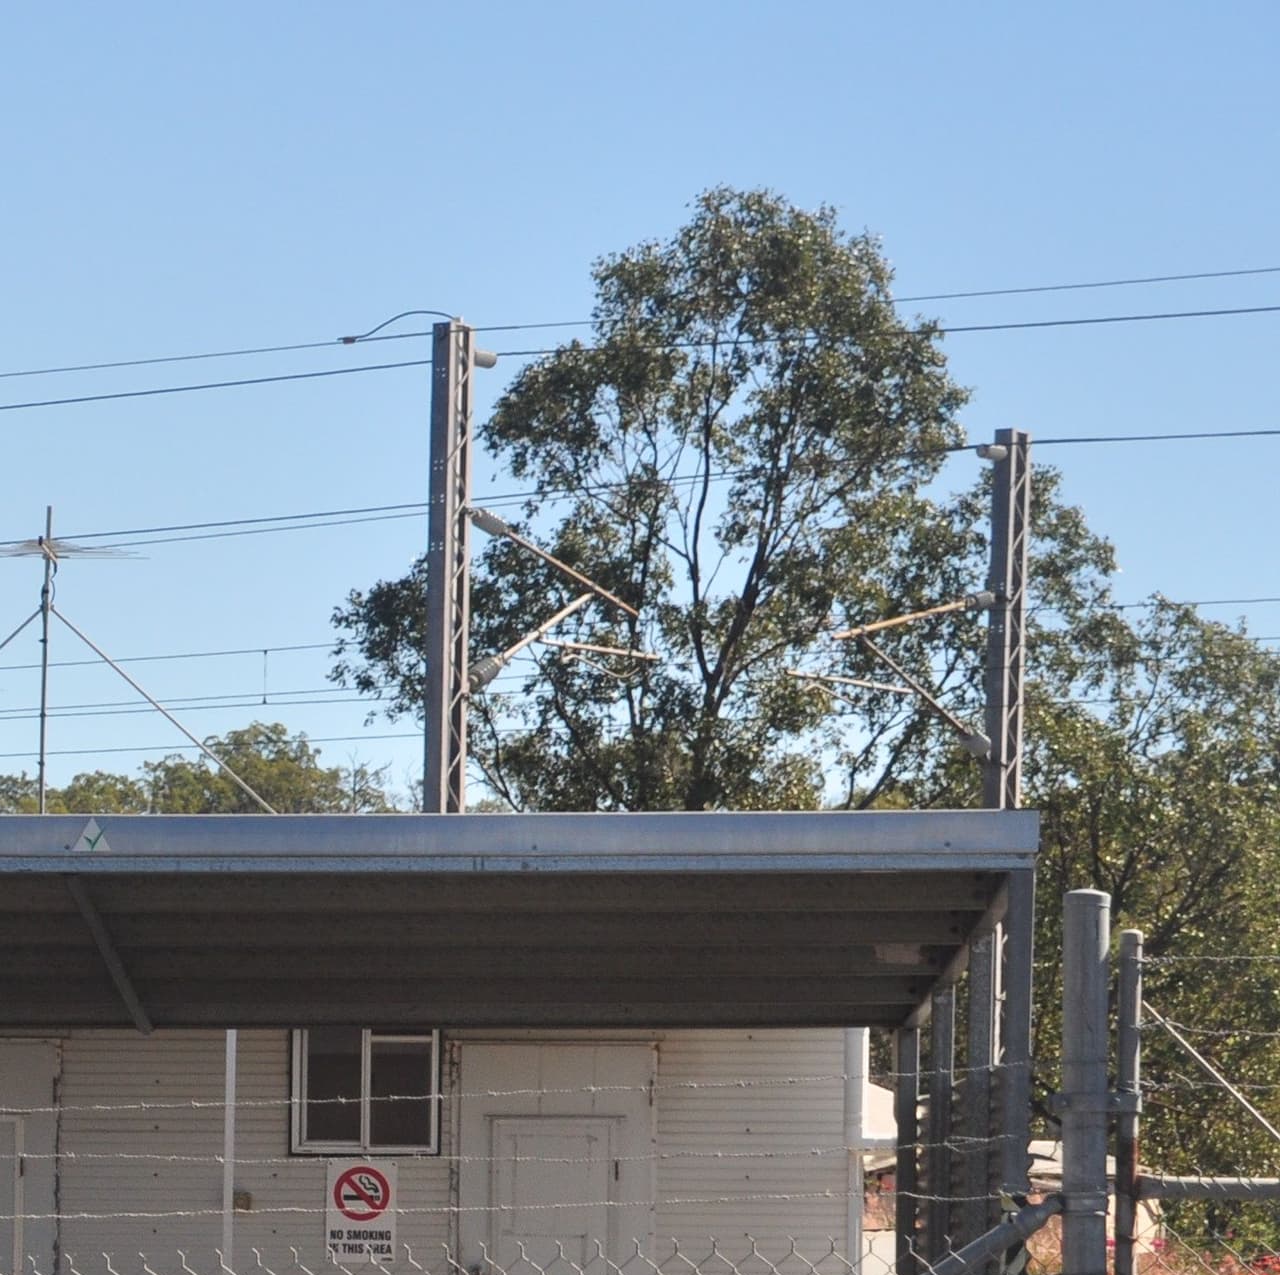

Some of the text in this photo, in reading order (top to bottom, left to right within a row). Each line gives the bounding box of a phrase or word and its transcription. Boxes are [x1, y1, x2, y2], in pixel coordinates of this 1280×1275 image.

[330, 1230, 392, 1241] NO SMOKING
[342, 1243, 364, 1254] THIS
[366, 1244, 392, 1254] AREA
